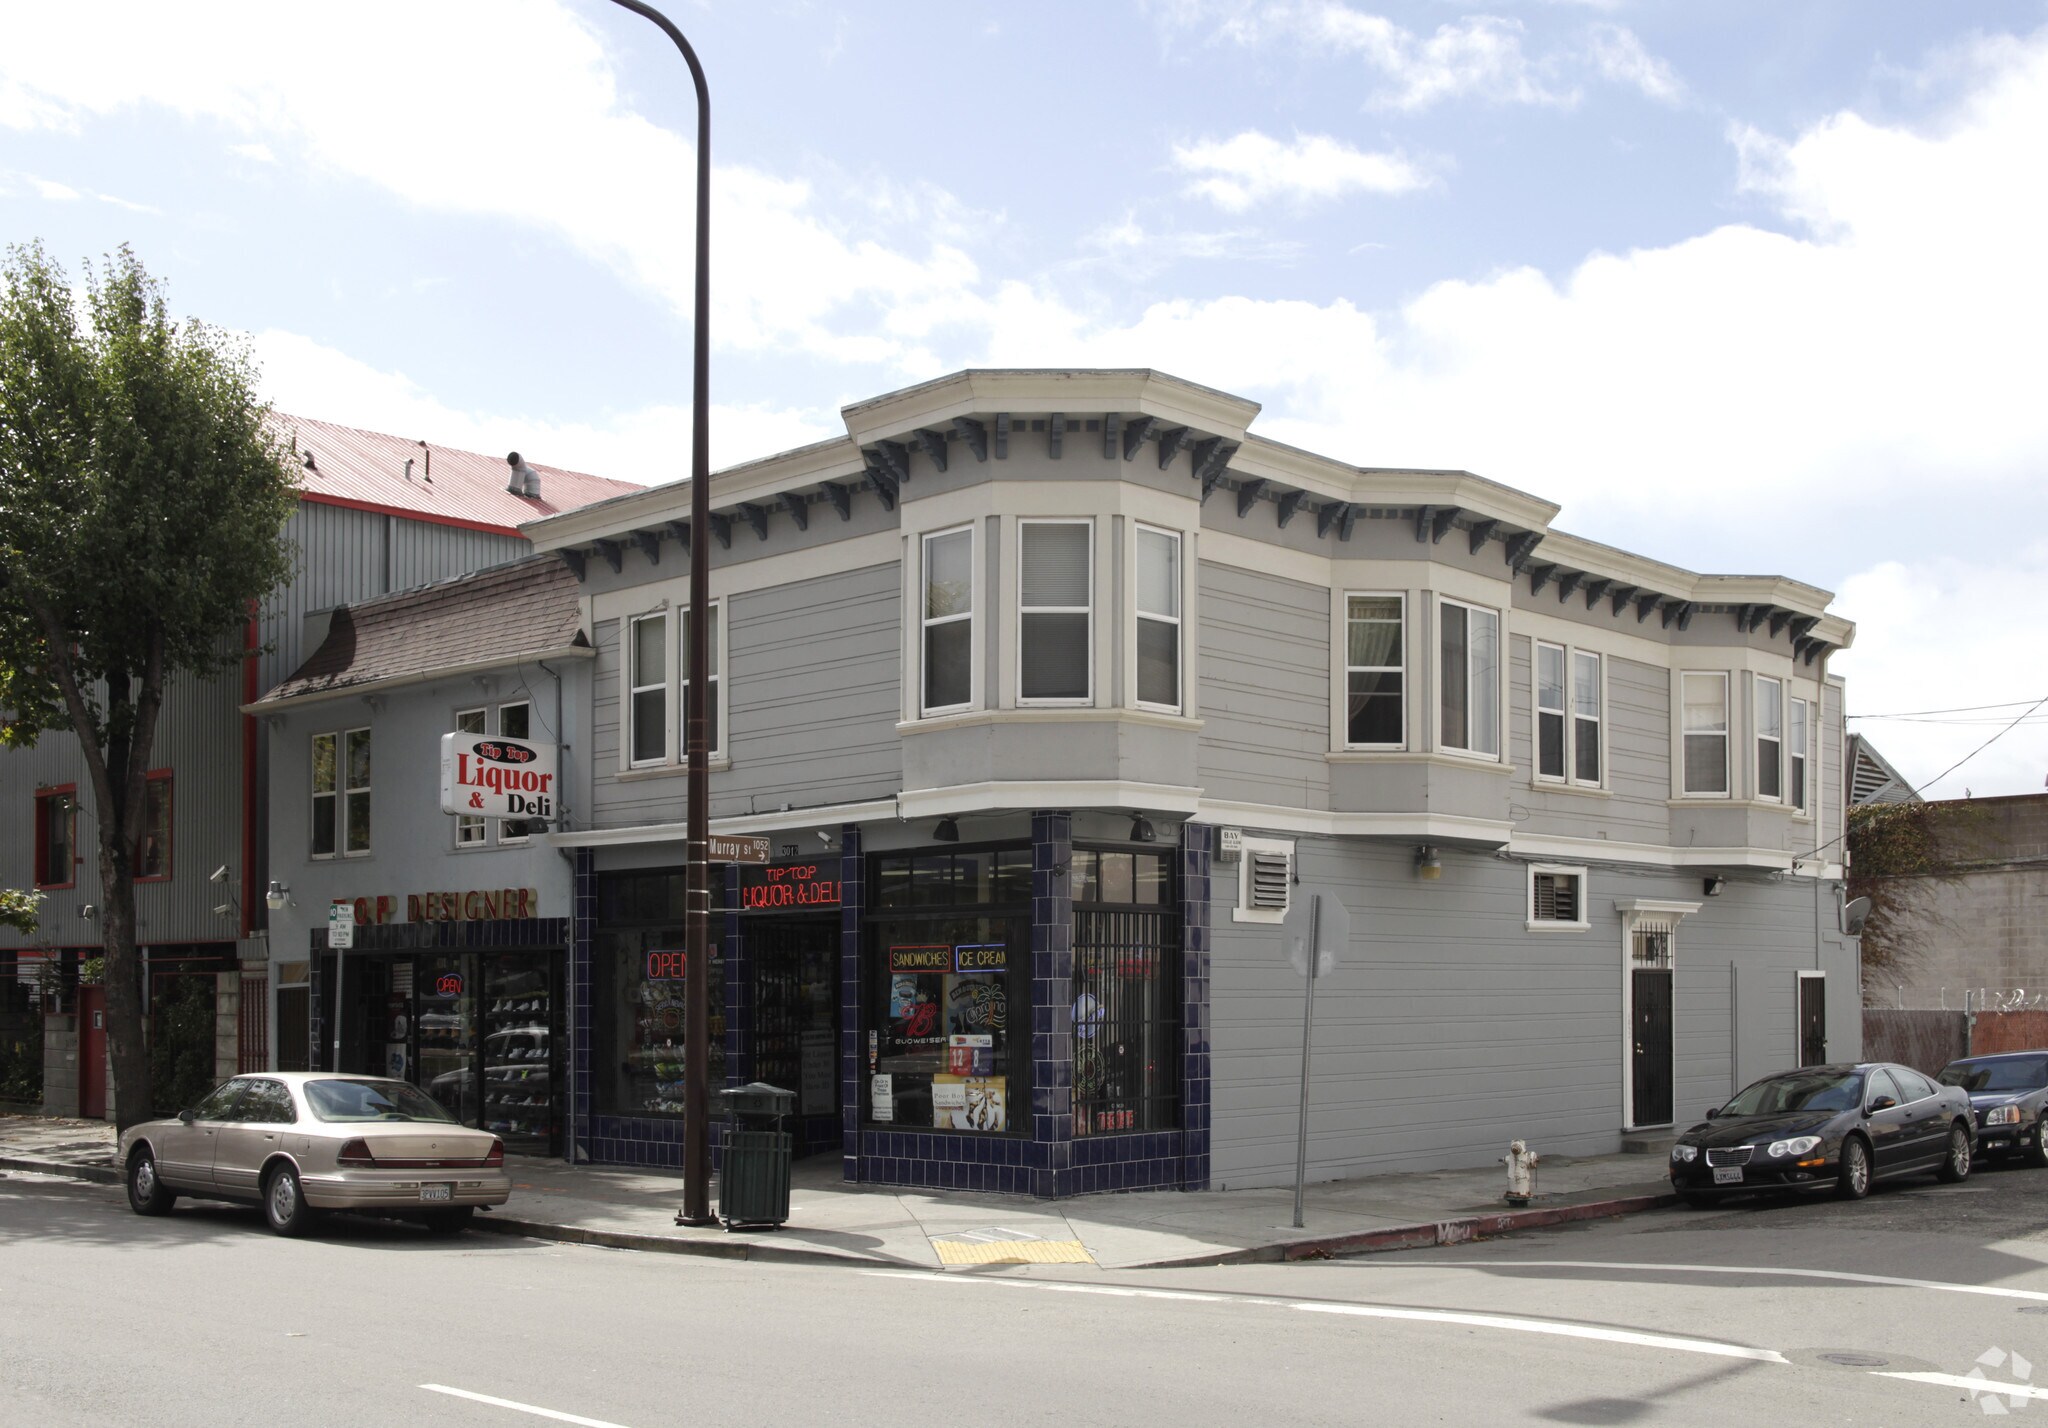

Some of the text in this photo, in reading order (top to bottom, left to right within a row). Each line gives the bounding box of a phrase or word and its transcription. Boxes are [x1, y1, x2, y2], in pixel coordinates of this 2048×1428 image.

[480, 742, 529, 763] Tip Top
[457, 753, 553, 795] Liquor
[468, 791, 551, 816] & Deli
[1223, 831, 1239, 839] BAY
[709, 838, 740, 859] Murray
[753, 840, 769, 851] 1052
[743, 881, 841, 908] LIQUOR & DELI
[332, 888, 537, 925] OP DESIGNER
[893, 951, 949, 967] SANDWICHES
[959, 951, 974, 966] ICE
[436, 976, 462, 994] OPEN
[895, 1036, 947, 1045] BUDWEISER
[952, 1049, 963, 1068] 12
[973, 1049, 979, 1068] 8
